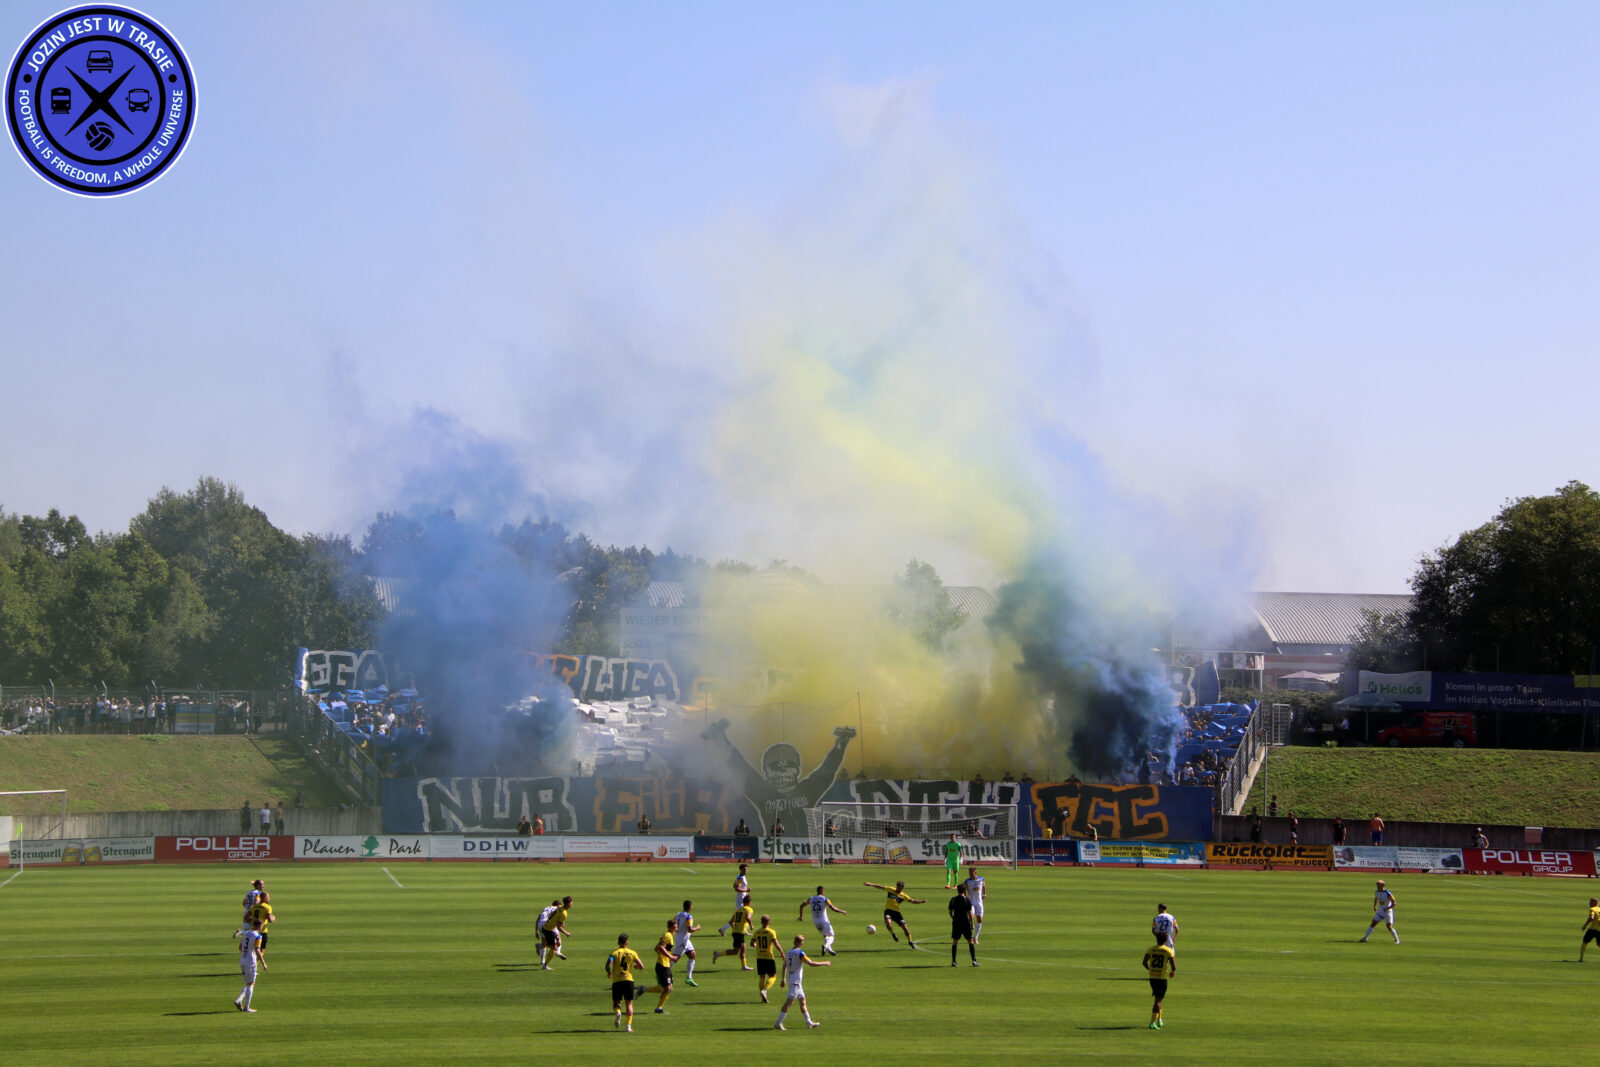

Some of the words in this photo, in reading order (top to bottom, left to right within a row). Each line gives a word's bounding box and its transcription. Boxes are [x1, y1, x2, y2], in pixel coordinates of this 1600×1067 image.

[625, 615, 670, 625] WIEDER
[580, 655, 681, 705] LIGA
[1380, 683, 1423, 695] Helios
[1445, 683, 1475, 691] Komm
[1488, 684, 1514, 692] unser
[1516, 685, 1543, 693] Team
[1458, 695, 1488, 704] Helios
[1490, 696, 1582, 707] Vogtland-Klinikum
[417, 777, 578, 833] NUR
[1030, 782, 1170, 839] FCC
[176, 836, 271, 851] POLLER
[303, 838, 355, 855] Plauen
[389, 838, 421, 855] Park
[463, 840, 530, 852] DDHW
[763, 836, 854, 857] Sternquell
[921, 838, 1012, 860] Stenquell
[102, 846, 152, 857] Sternquell
[1212, 844, 1307, 858] Rückoldt
[1482, 849, 1572, 865] POLLER
[1533, 865, 1573, 873] GROUP
[812, 901, 822, 912] 25
[1158, 920, 1169, 931] 27
[757, 935, 767, 949] 10
[620, 956, 628, 971] 4
